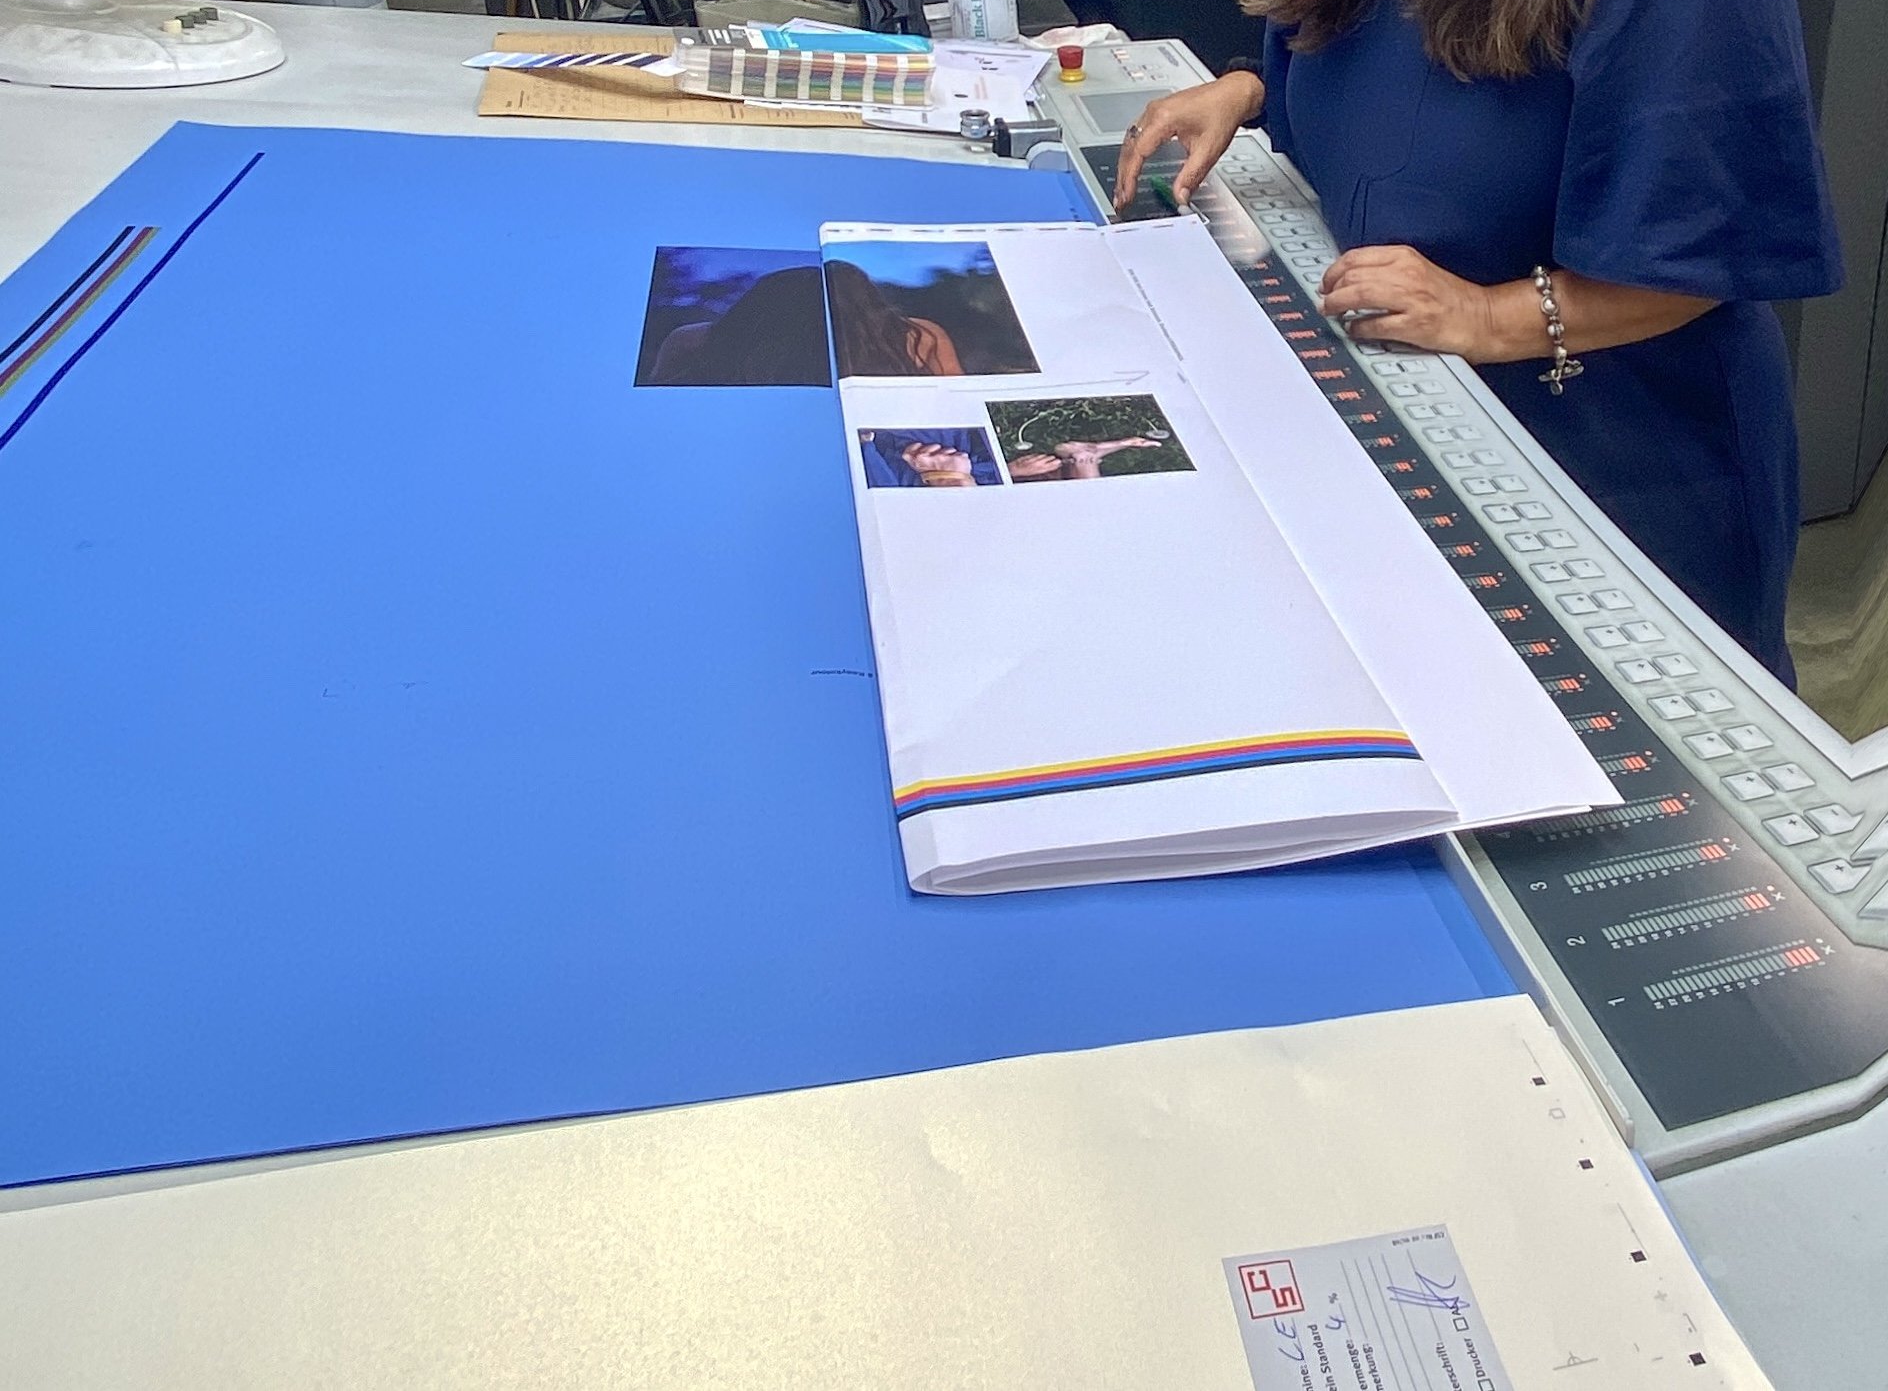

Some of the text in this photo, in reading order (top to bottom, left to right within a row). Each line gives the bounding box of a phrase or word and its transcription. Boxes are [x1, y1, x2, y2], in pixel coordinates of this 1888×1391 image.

[973, 4, 985, 38] Black
[1530, 880, 1548, 892] 3
[1566, 934, 1586, 948] 2
[1608, 994, 1626, 1008] 1
[1328, 1292, 1339, 1305] %
[1324, 1314, 1347, 1331] 4
[1307, 1323, 1332, 1374] Standard
[1463, 1337, 1487, 1379] Drucker
